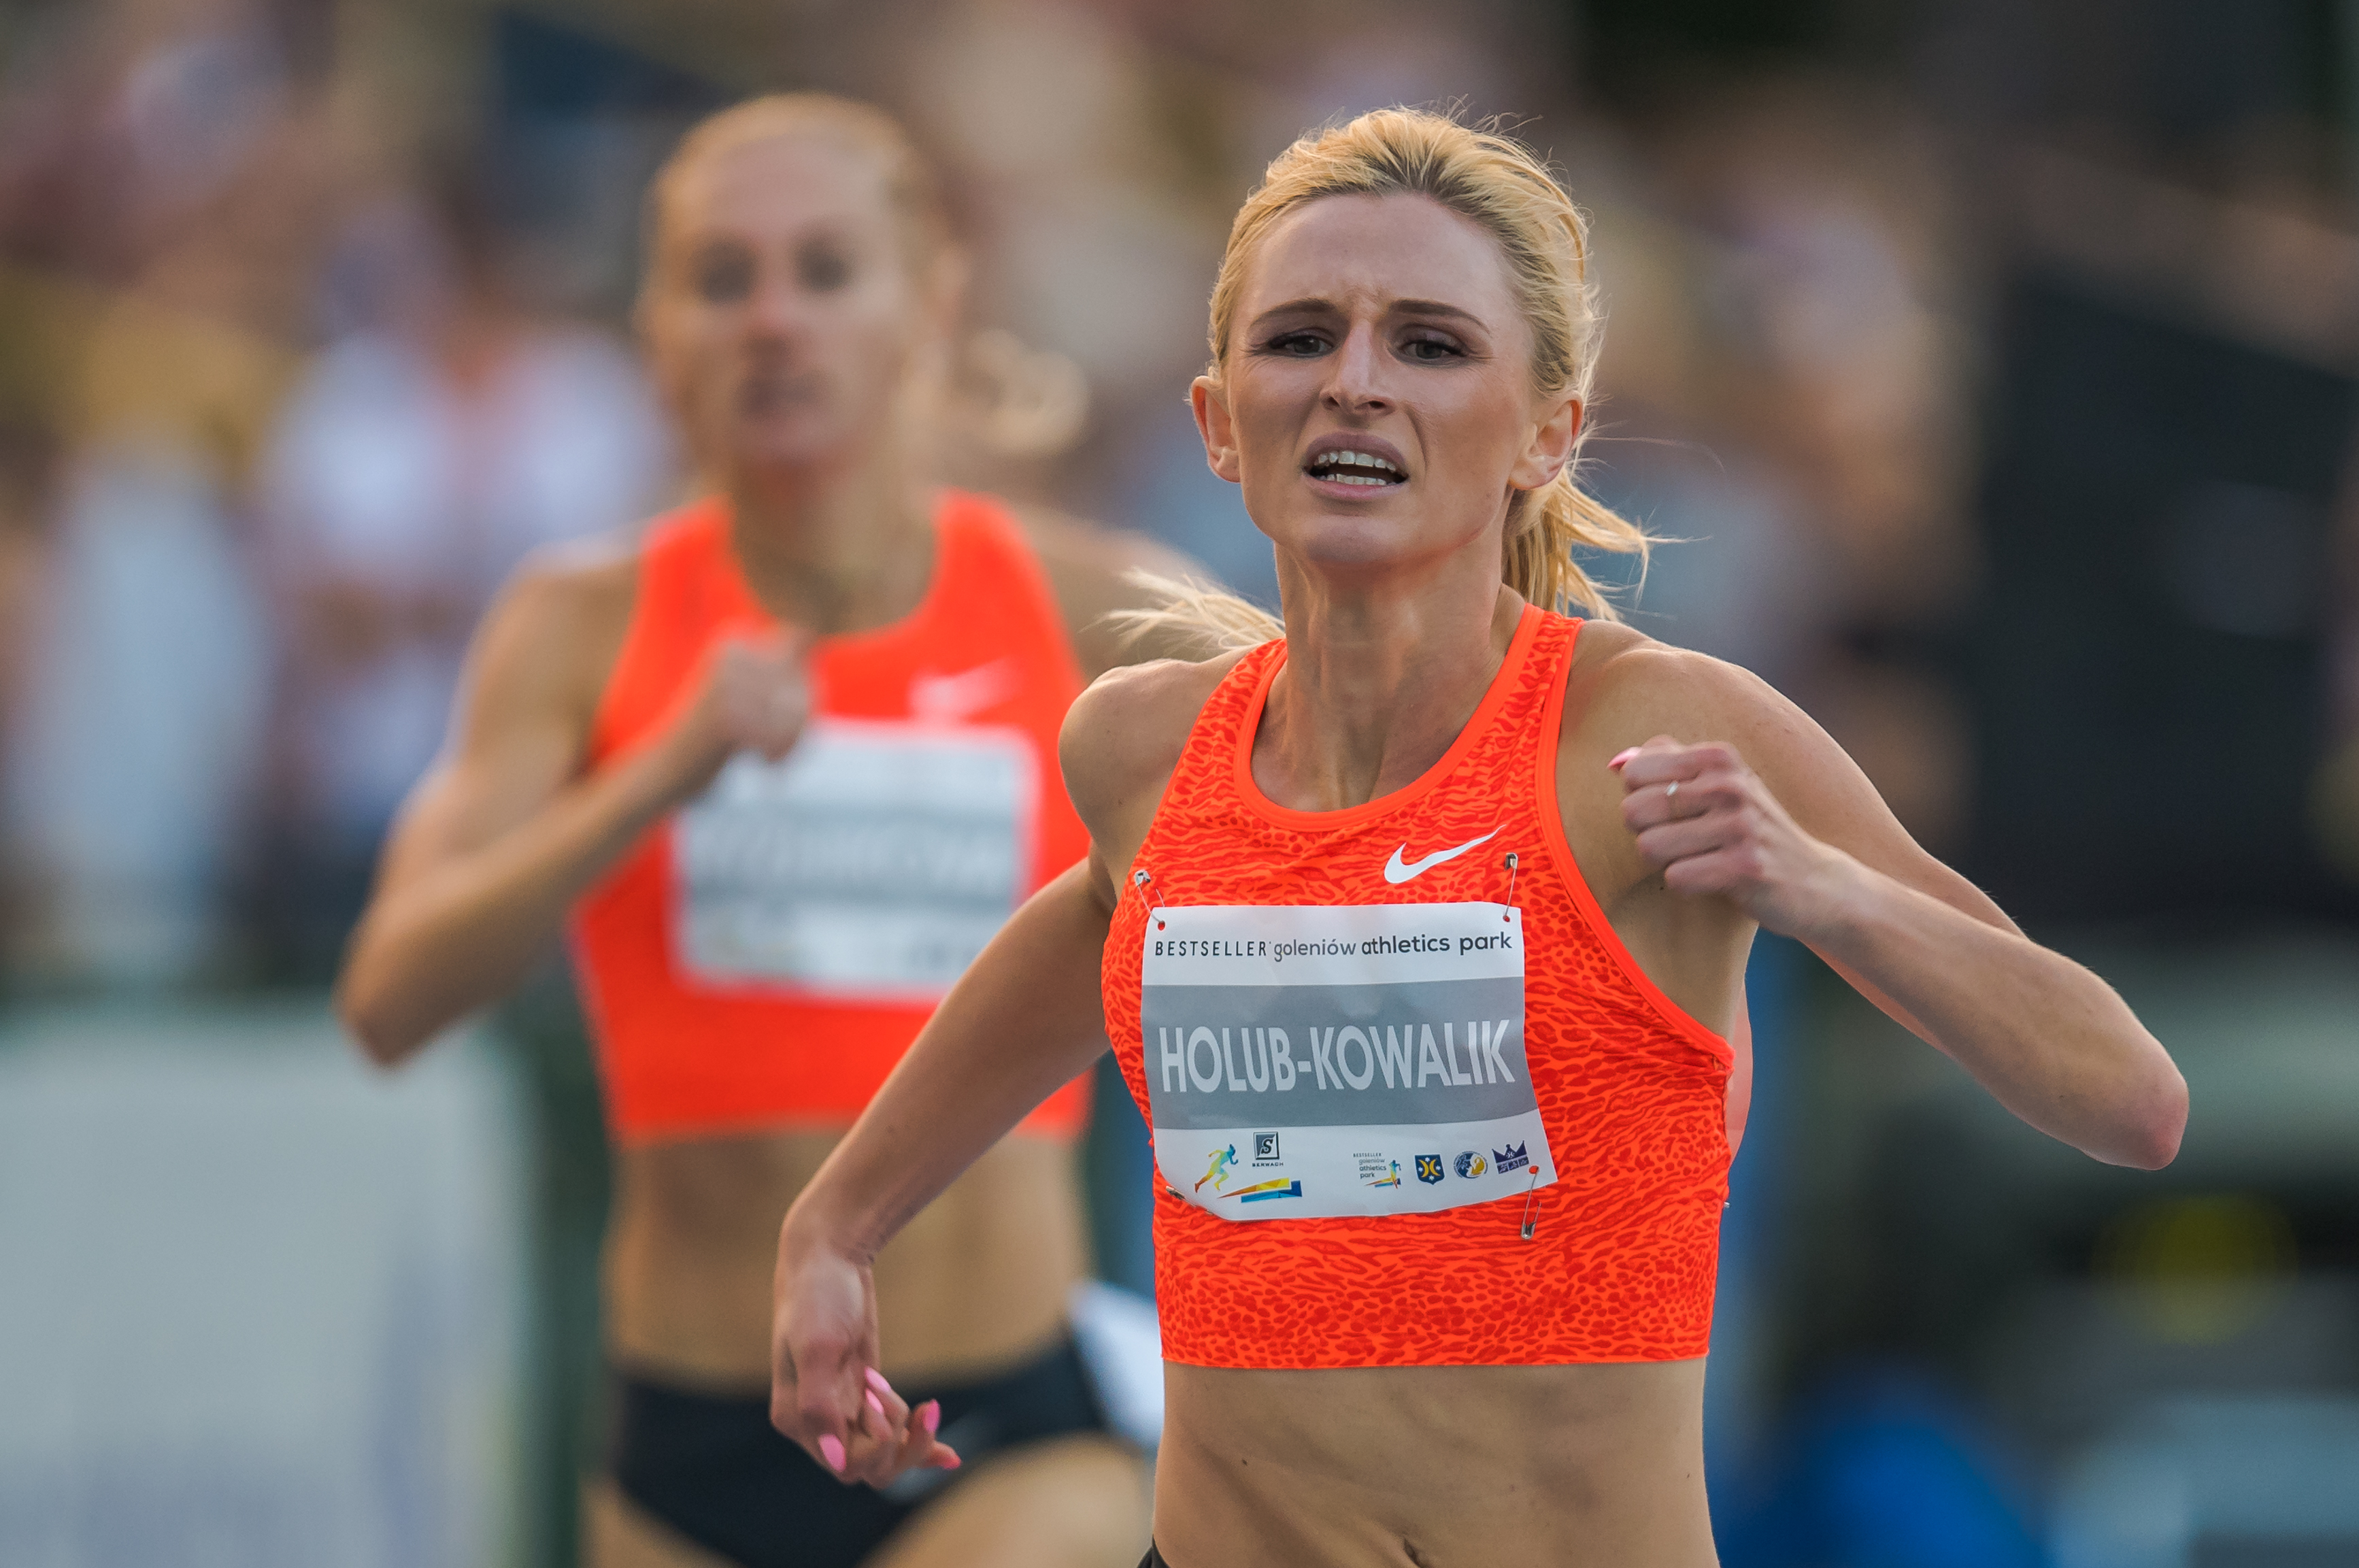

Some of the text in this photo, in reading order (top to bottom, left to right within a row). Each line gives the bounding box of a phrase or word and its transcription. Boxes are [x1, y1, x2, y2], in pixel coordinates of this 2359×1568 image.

[1155, 931, 1512, 962] BESTSELLER goleniów athletics park
[1159, 1020, 1516, 1092] HOLUB-KOWALIK
[1261, 1138, 1273, 1154] S
